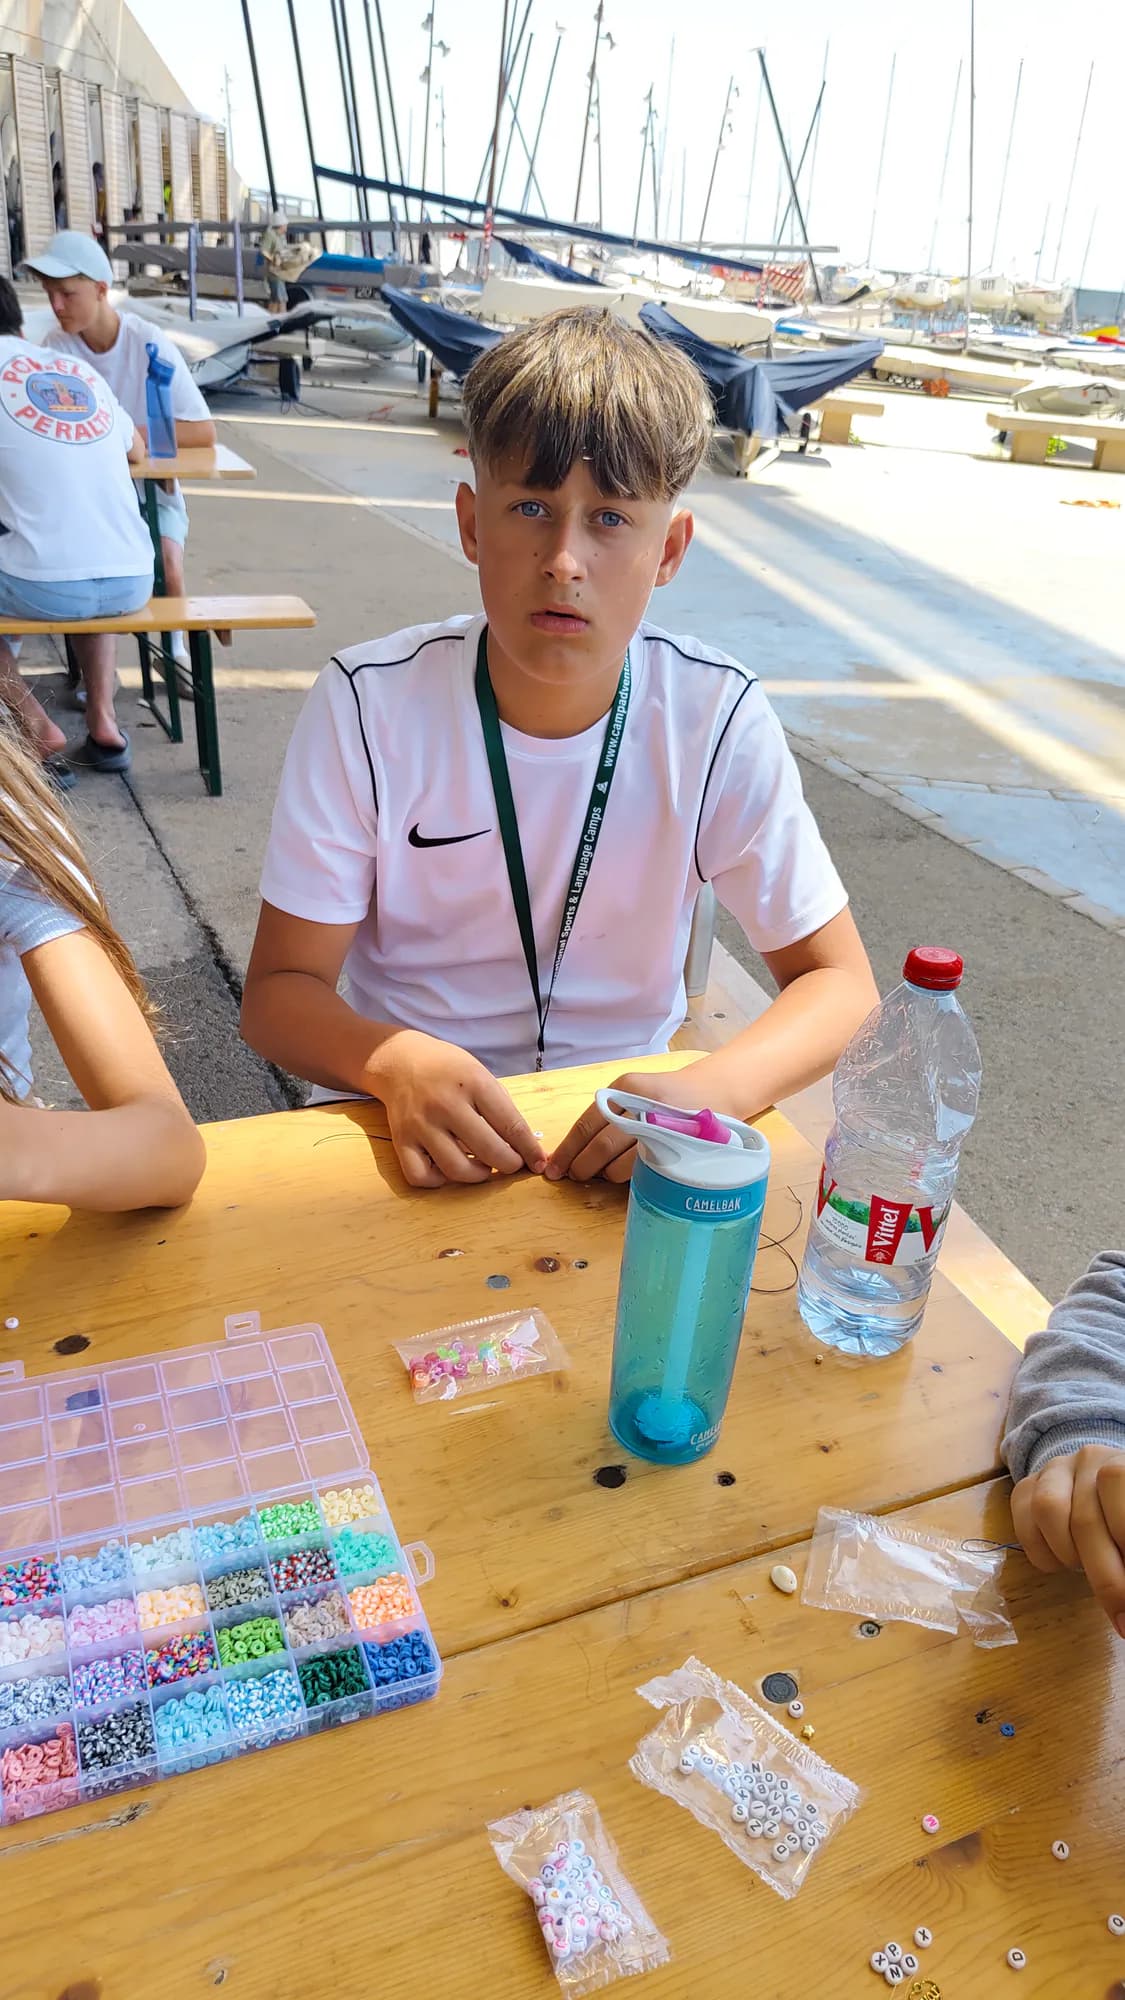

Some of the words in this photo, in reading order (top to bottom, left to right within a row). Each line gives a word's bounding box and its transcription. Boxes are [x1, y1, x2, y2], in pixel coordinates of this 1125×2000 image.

[584, 806, 602, 843] Camps
[571, 843, 594, 894] Language
[568, 895, 578, 904] &
[561, 904, 577, 938] Sports
[685, 1196, 742, 1212] CAMELBAK
[871, 1204, 901, 1248] Vittel
[690, 1415, 724, 1445] CAMEL
